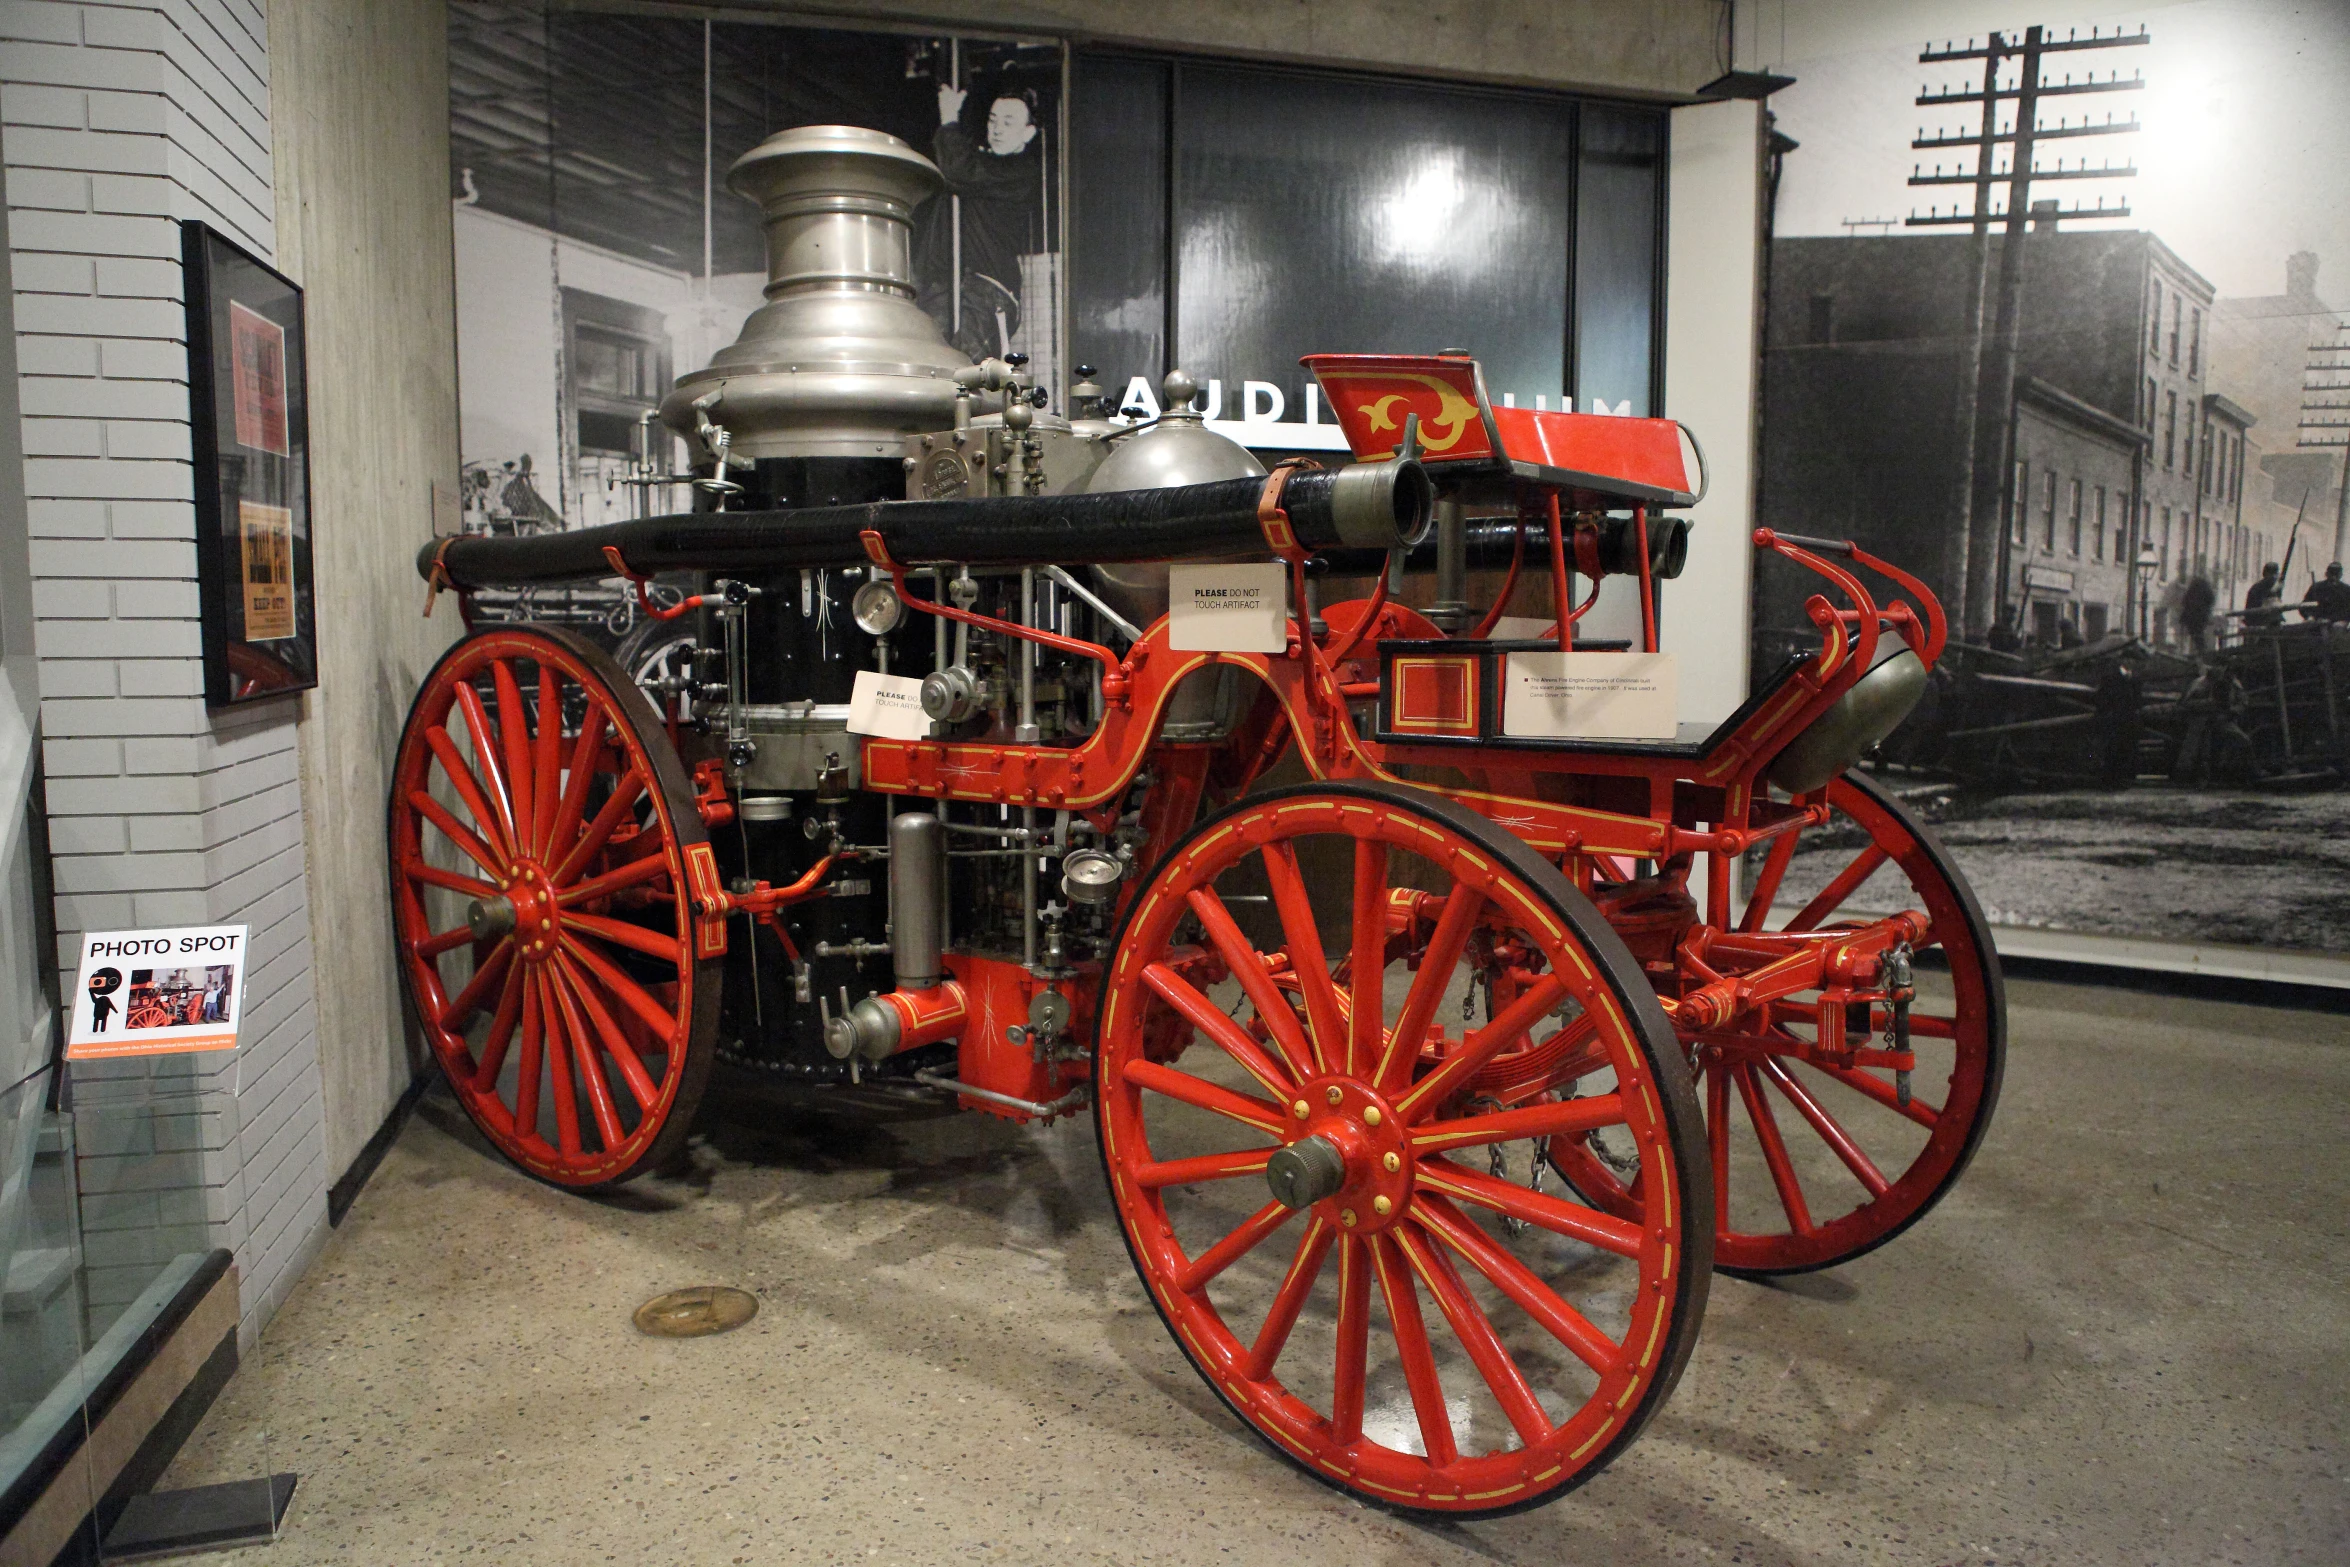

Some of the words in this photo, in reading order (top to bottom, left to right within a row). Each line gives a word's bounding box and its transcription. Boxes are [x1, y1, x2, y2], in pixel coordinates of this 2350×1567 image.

[1195, 589, 1228, 597] PLEASE
[1229, 588, 1242, 597] DO
[1242, 588, 1260, 597] NOT
[1194, 600, 1221, 609] TOUCH
[1222, 600, 1260, 609] ARTIFACT
[877, 691, 906, 700] PLEASE
[876, 699, 899, 707] TOUCH
[900, 703, 924, 711] ARTIFA
[90, 938, 171, 958] PHOTO
[179, 935, 240, 953] SPOT
